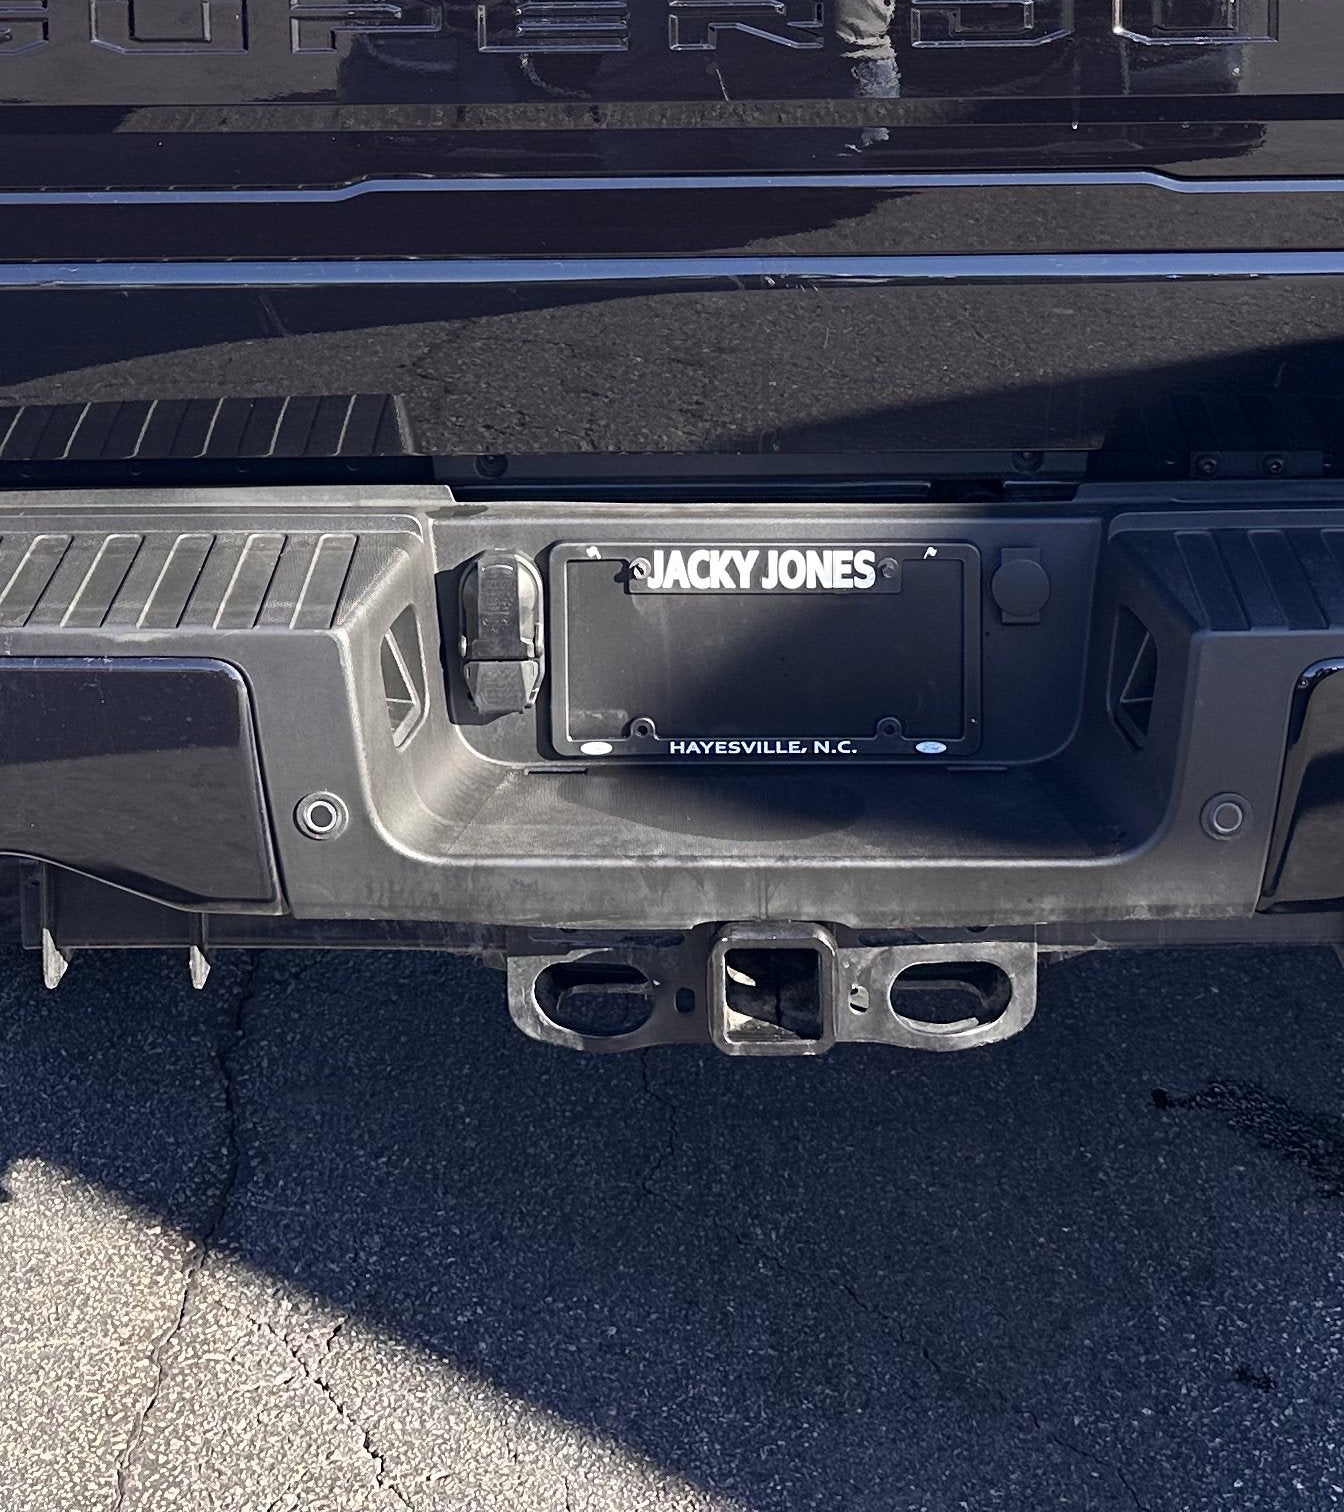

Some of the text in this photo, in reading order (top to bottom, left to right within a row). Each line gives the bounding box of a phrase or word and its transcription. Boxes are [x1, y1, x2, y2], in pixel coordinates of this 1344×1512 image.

[647, 549, 876, 589] JACKY JONES
[813, 740, 858, 754] N.C.
